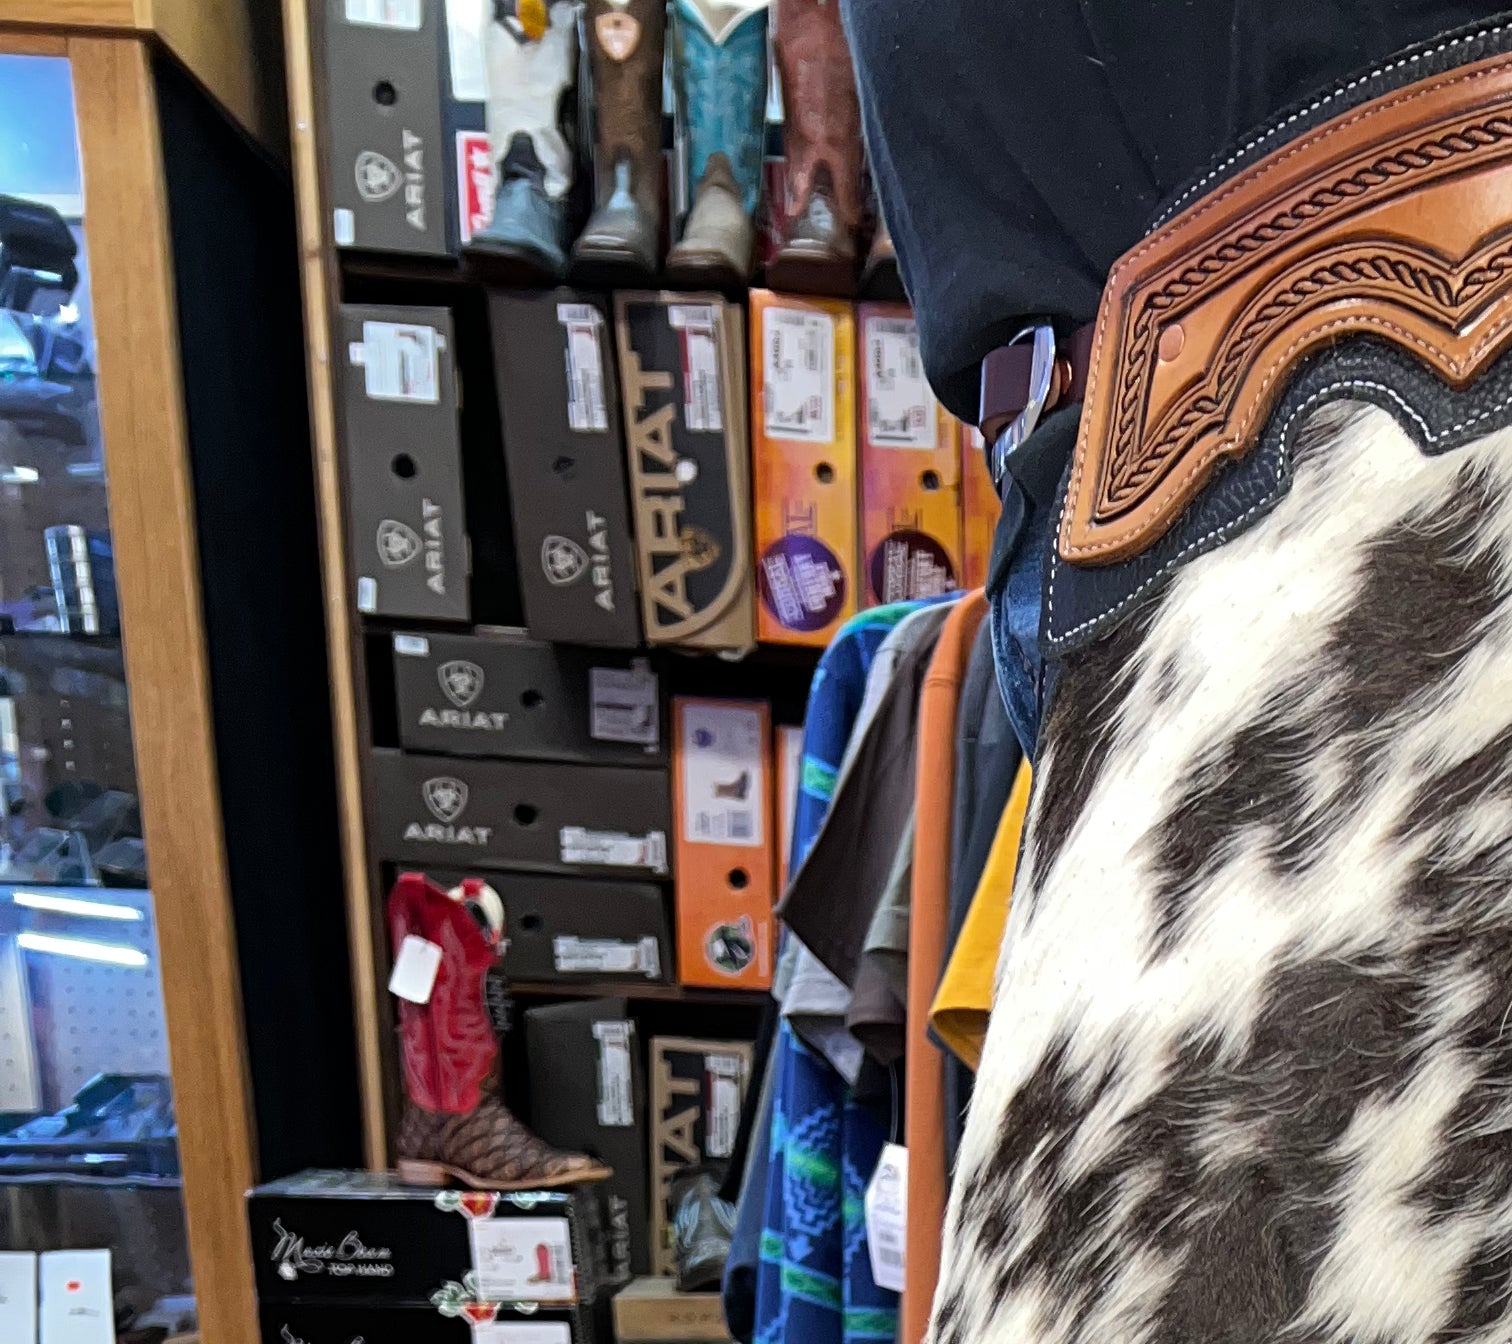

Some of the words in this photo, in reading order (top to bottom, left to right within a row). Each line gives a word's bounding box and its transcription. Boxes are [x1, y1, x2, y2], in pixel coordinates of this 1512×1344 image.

[402, 128, 427, 232] ARIAT
[626, 351, 695, 620] ARIAT
[423, 498, 446, 595] ARIAT
[585, 510, 615, 613] ARIAT
[418, 707, 510, 731] ARIAT
[403, 822, 493, 846] ARIAT
[328, 1262, 354, 1277] TOP
[355, 1262, 394, 1277] HAND
